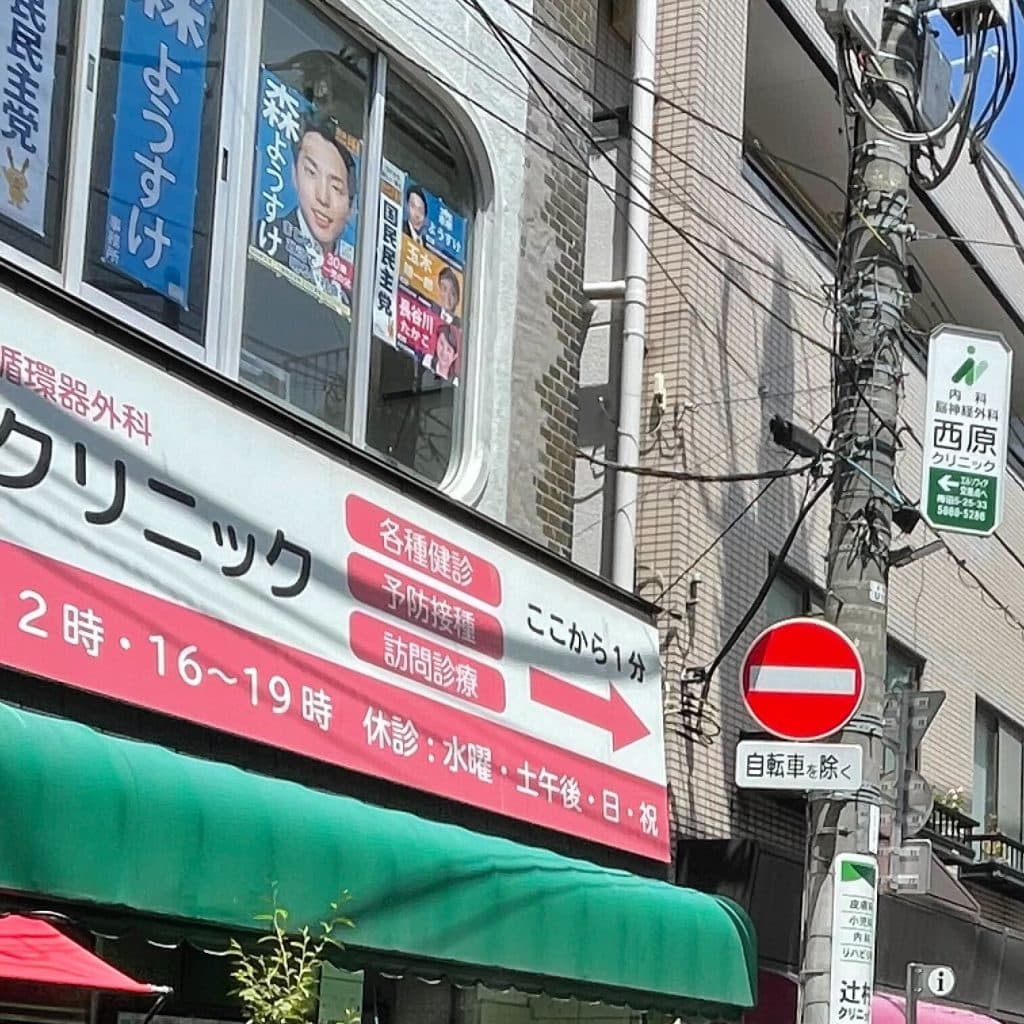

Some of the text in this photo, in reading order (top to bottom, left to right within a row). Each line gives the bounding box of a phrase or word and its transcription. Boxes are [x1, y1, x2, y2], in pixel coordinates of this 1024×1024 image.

[378, 202, 399, 317] 国民民主党
[931, 452, 996, 473] クリニック
[933, 418, 998, 456] 西原
[379, 516, 474, 588] 各種健診
[382, 573, 477, 647] 予防接種
[526, 602, 646, 684] ここから1分
[383, 631, 479, 700] 訪問診療
[746, 752, 851, 780] 自転車を除く
